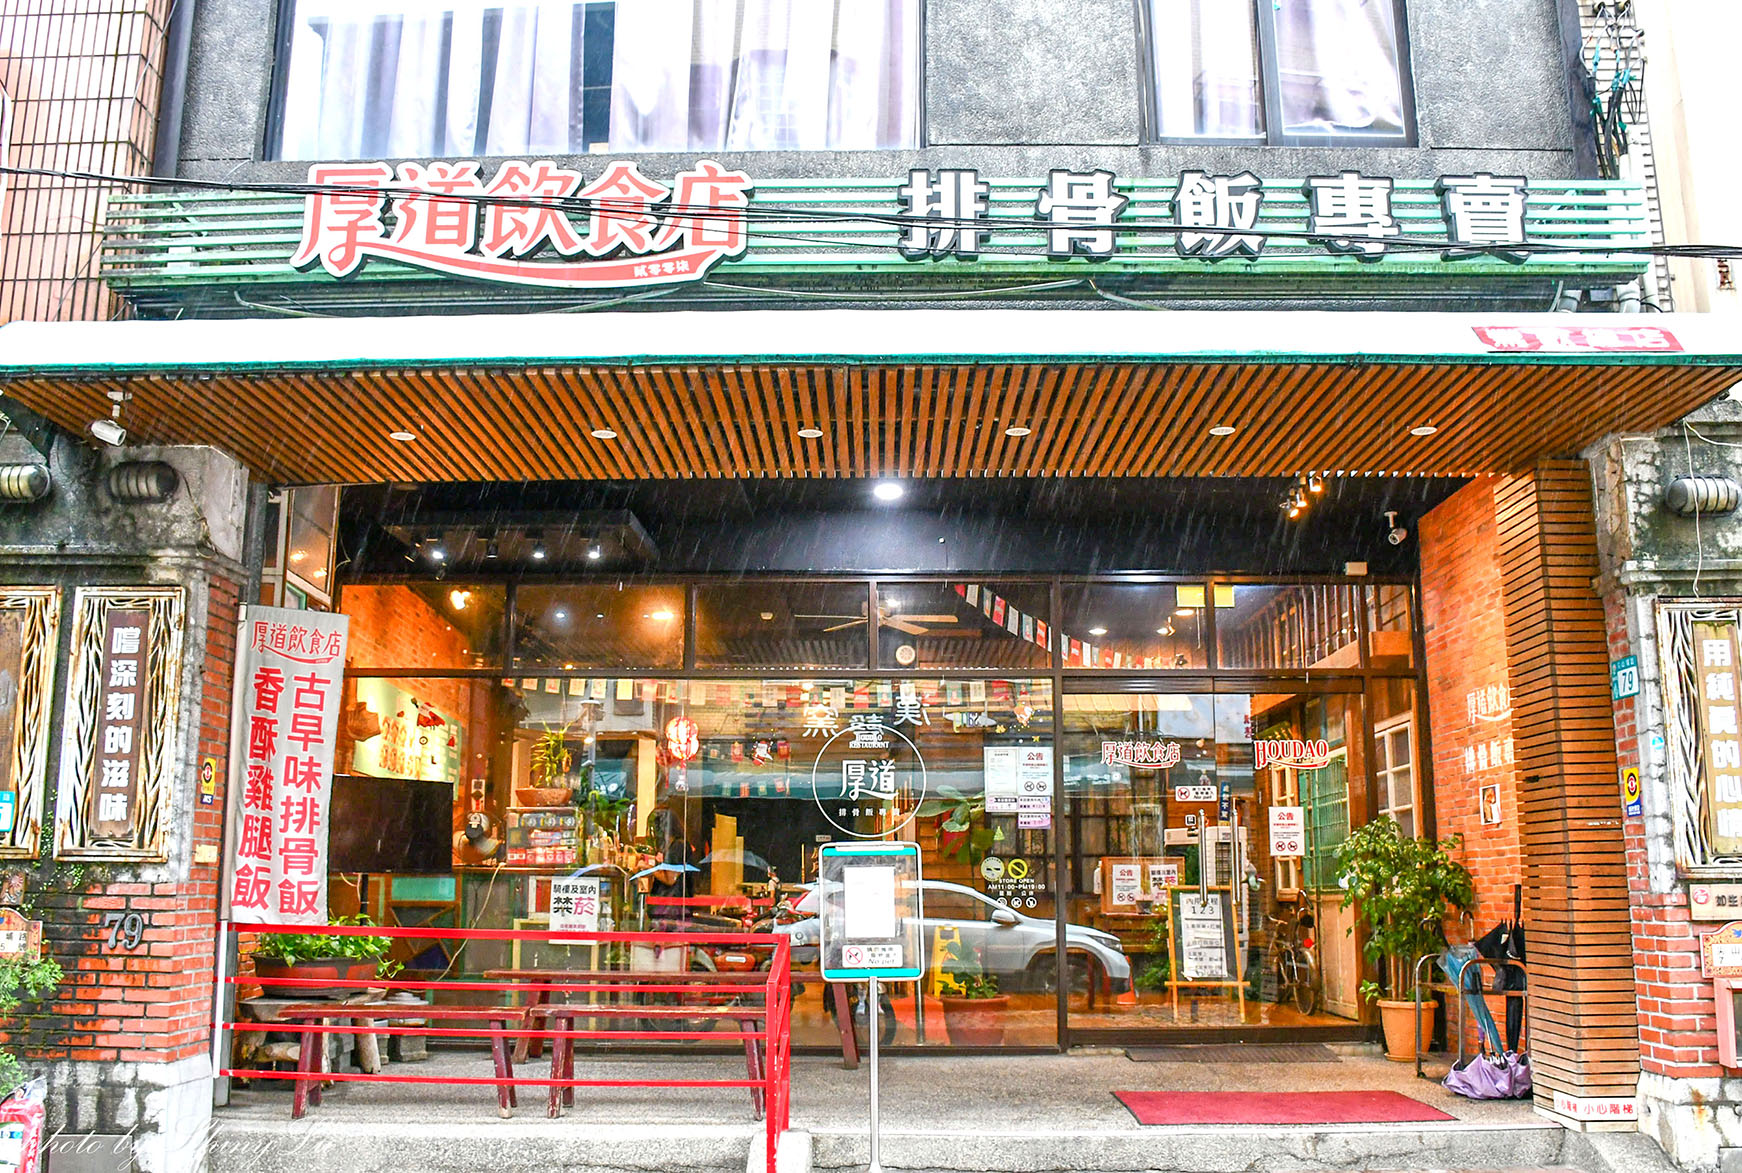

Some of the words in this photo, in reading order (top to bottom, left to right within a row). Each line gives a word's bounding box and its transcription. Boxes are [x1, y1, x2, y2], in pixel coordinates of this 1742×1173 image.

[293, 162, 752, 276] 厚道飲食店
[899, 171, 1529, 263] 排骨飯專賣
[251, 621, 342, 657] 厚道飲食店
[1622, 671, 1634, 692] 79
[1027, 752, 1043, 760] 公告
[1101, 741, 1181, 768] 厚道飲食店
[1253, 740, 1331, 769] HOUDAO
[231, 666, 285, 912] 香酥雞腿飯
[277, 672, 332, 916] 古早味排骨飯
[839, 759, 900, 802] 厚道
[1278, 812, 1294, 820] 公告
[1208, 905, 1215, 914] 3
[104, 913, 143, 950] 79
[1583, 1103, 1634, 1115] 小心階梯
